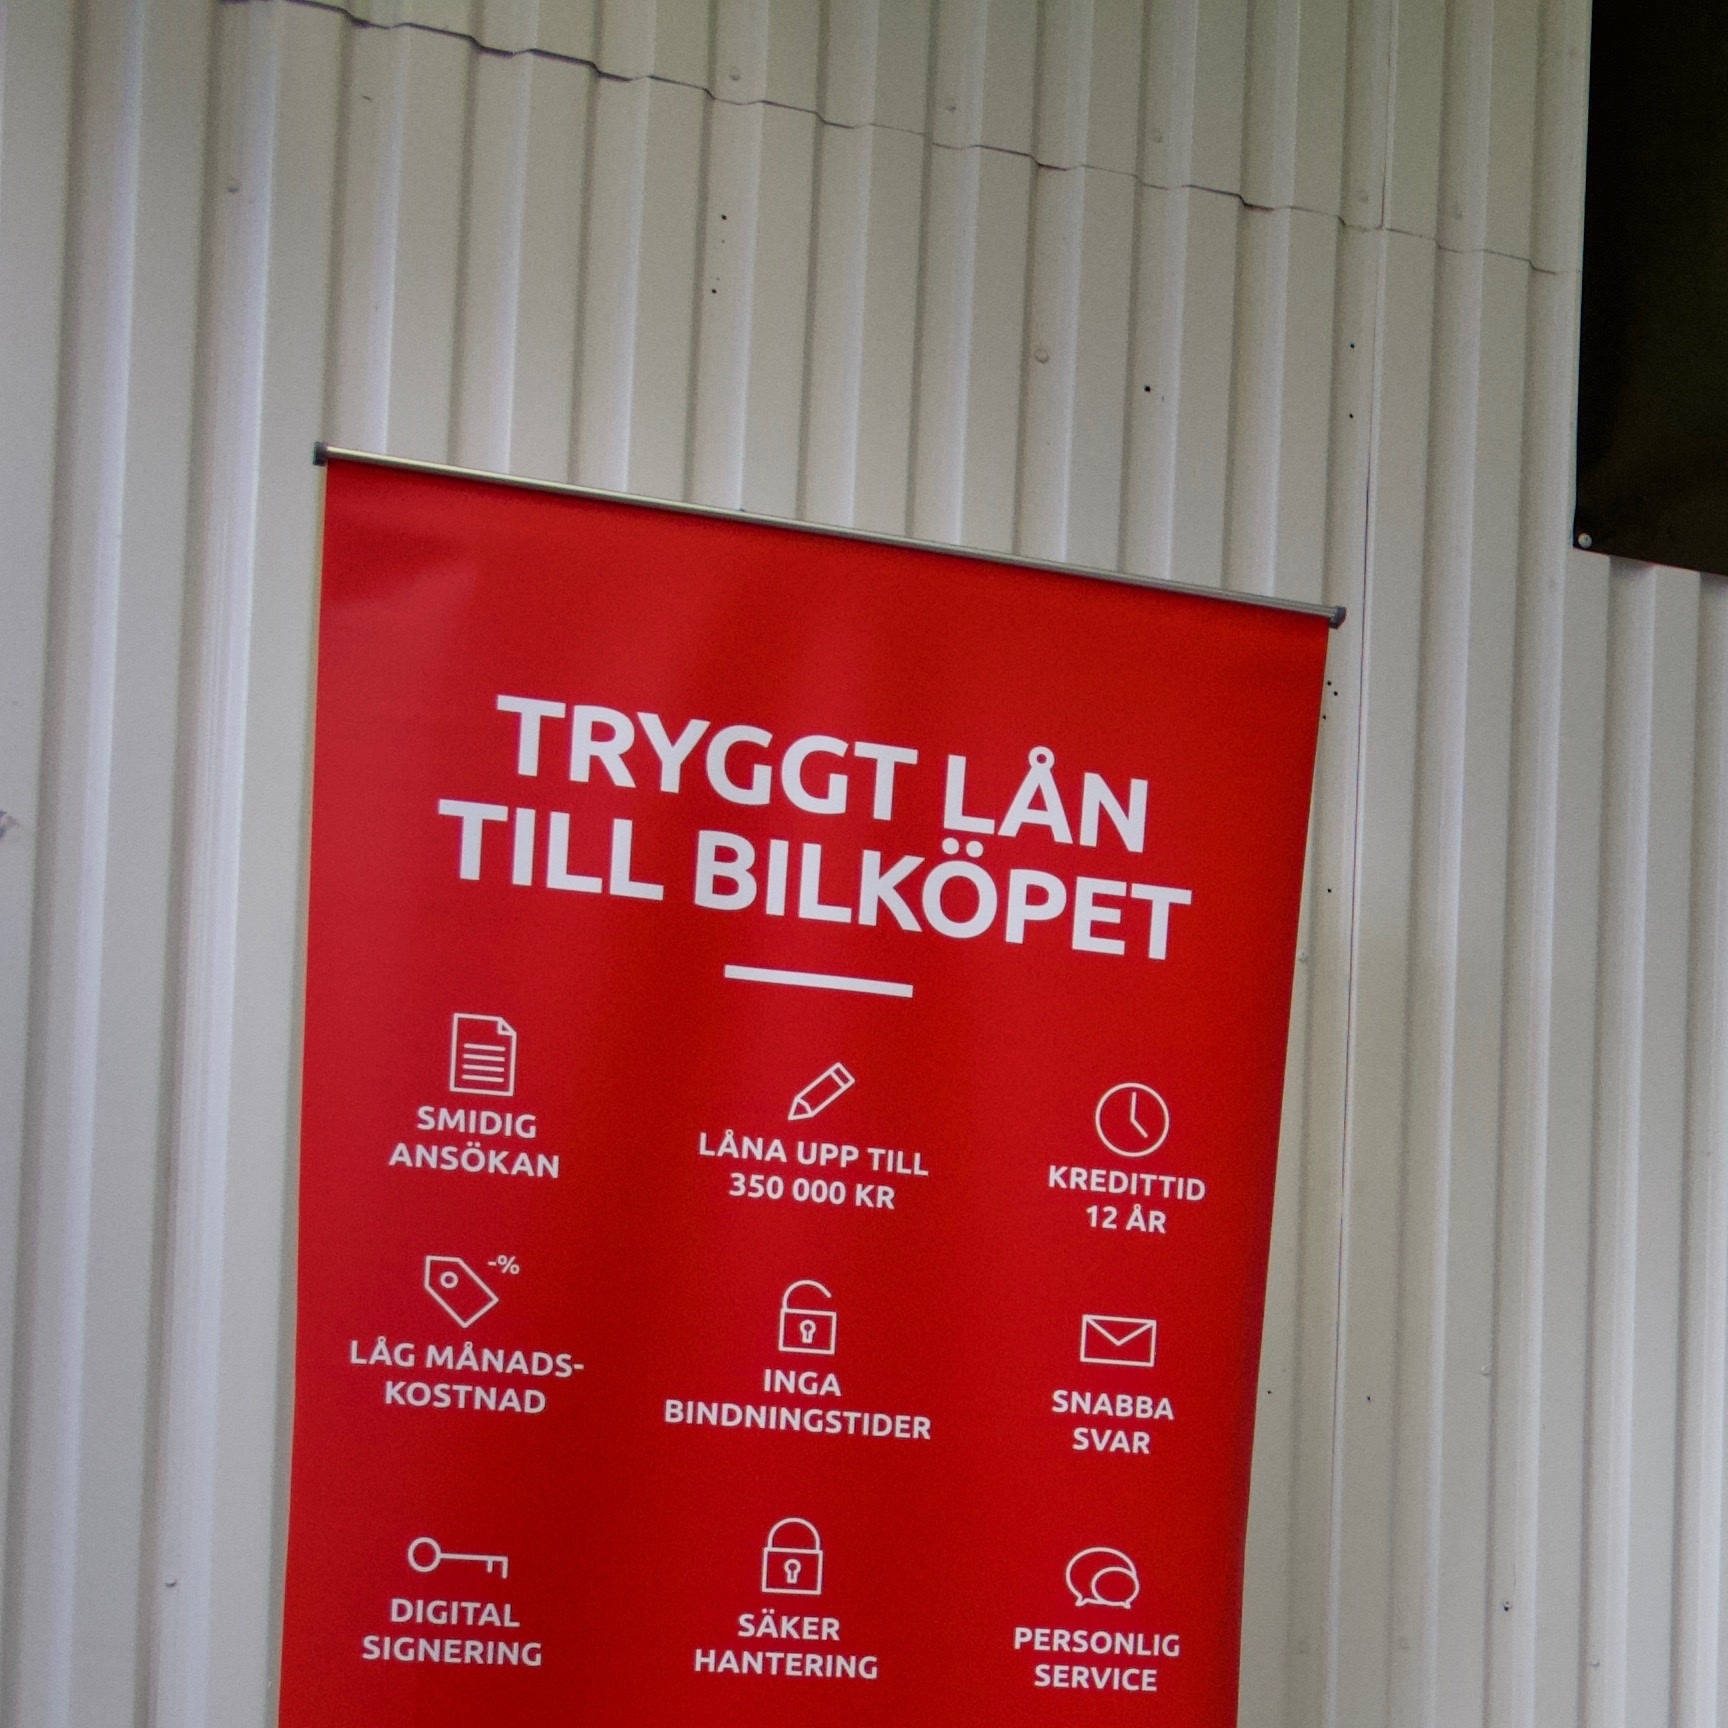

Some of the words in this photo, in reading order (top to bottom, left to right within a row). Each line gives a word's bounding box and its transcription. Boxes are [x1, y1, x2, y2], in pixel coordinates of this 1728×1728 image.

[496, 694, 919, 819] TRYGGT
[941, 746, 1149, 853] LÅN
[437, 798, 664, 901] TILL
[694, 836, 1193, 961] BILKÖPET
[416, 1105, 537, 1139] SMIDIG
[388, 1142, 560, 1179] ANSÖKAN
[699, 1128, 788, 1163] LÅNA
[796, 1140, 860, 1168] UPP
[866, 1147, 929, 1177] TILL
[728, 1171, 785, 1200] 350
[791, 1177, 847, 1205] 000
[854, 1183, 895, 1210] KR
[1048, 1164, 1206, 1203] KREDITTID
[1086, 1204, 1118, 1230] 12
[1125, 1203, 1167, 1234] ÅR
[350, 1335, 416, 1368] LÅG
[425, 1340, 585, 1378] MÅNADS-
[384, 1380, 547, 1414] KOSTNAD
[763, 1368, 842, 1397] INGA
[664, 1398, 931, 1440] BINDNINGSTIDER
[1051, 1389, 1175, 1421] SNABBA
[1072, 1426, 1151, 1455] SVAR
[390, 1597, 520, 1628] DIGITAL
[737, 1608, 840, 1641] SÄKER
[362, 1634, 542, 1667] SIGNERING
[1013, 1626, 1180, 1658] PERSONLIG
[694, 1648, 878, 1680] HANTERING
[1033, 1663, 1158, 1692] SERVICE
